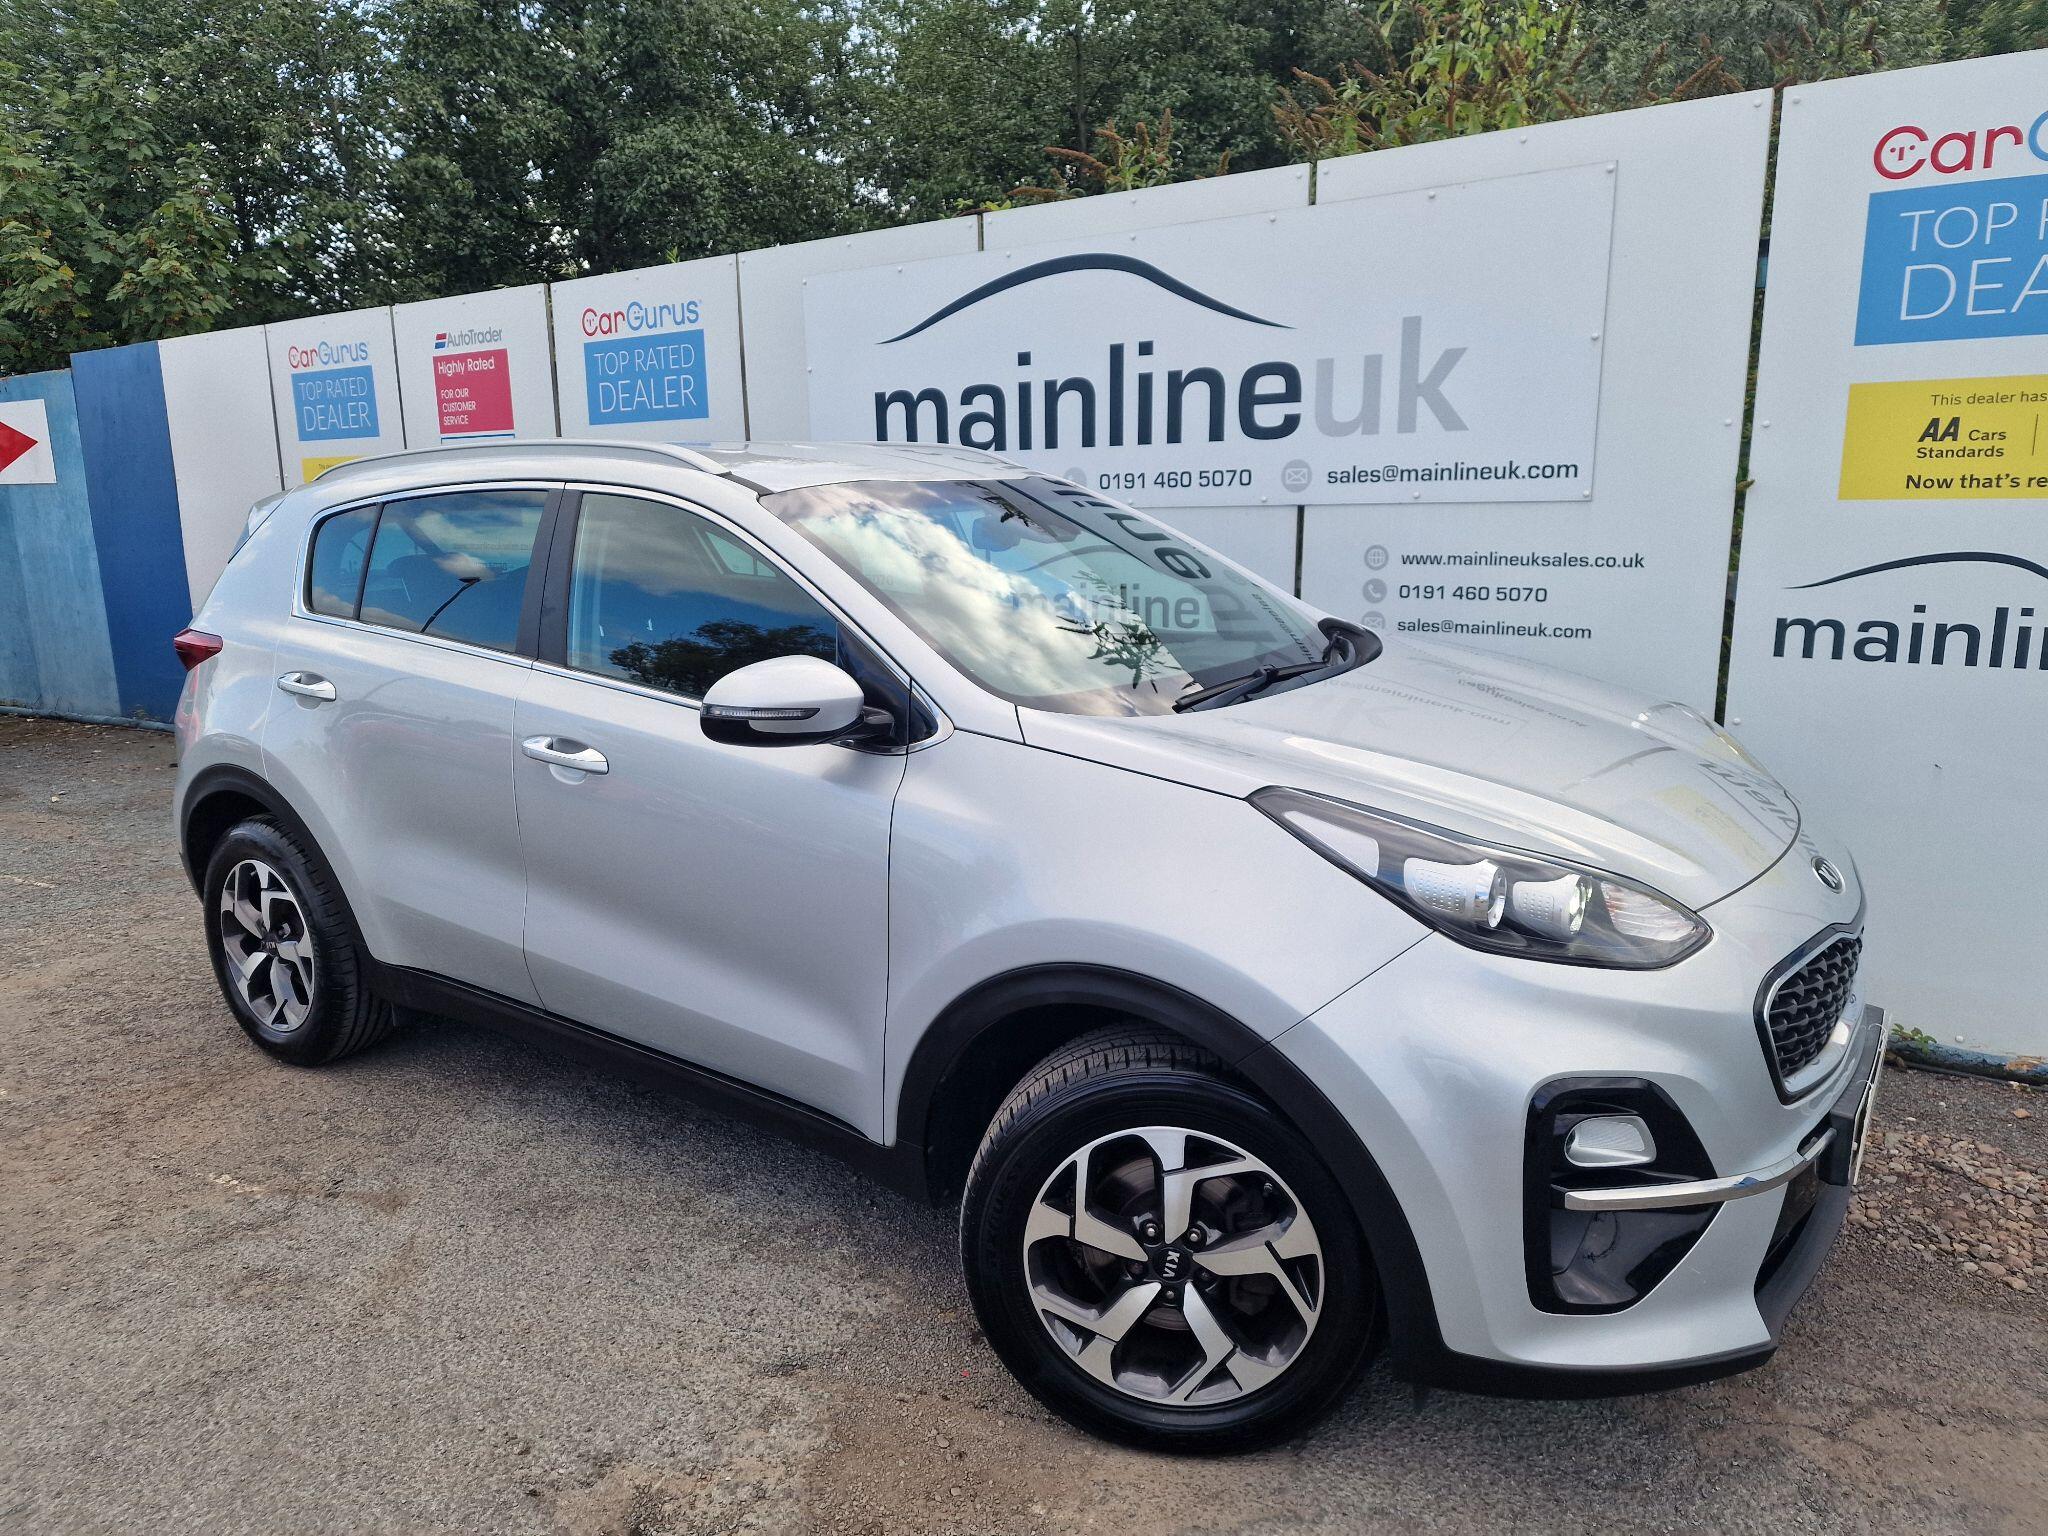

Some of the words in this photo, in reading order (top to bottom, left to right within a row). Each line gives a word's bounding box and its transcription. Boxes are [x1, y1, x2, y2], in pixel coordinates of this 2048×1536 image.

[1900, 202, 2018, 252] TOP
[581, 300, 700, 337] CarGurus
[447, 327, 503, 348] AutoTrader
[288, 341, 369, 369] CarGurus
[593, 350, 630, 376] TOP
[634, 343, 695, 372] RATED
[437, 360, 465, 377] Highly
[467, 356, 496, 372] Rated
[298, 380, 322, 401] TOP
[325, 376, 368, 398] RATED
[440, 389, 454, 399] FOR
[455, 387, 469, 398] OUR
[599, 374, 697, 413] DEALER
[1931, 393, 1962, 406] This
[1966, 392, 2016, 405] dealer
[2020, 391, 2048, 403] has
[303, 401, 372, 432] DEALER
[442, 401, 476, 412] CUSTOMER
[443, 414, 469, 426] SERVICE
[1917, 416, 1961, 443] AA
[1968, 429, 2007, 441] Cars
[1916, 445, 2005, 459] Standards
[1099, 472, 1146, 490] 0191
[1153, 471, 1192, 488] 460
[1198, 469, 1252, 487] 5070
[1326, 460, 1579, 485] sales@mainlineuk.com
[1905, 474, 1954, 490] Now
[1959, 473, 2021, 489] that's
[1400, 550, 1646, 569] www.mainlineuksales.co.uk
[1398, 584, 1446, 600] 0191
[1452, 585, 1490, 601] 460
[1496, 587, 1548, 602] 5070
[1397, 617, 1592, 639] sales@mainlineuk.com
[1772, 604, 2048, 671] mainli
[1162, 1250, 1180, 1278] KIA
